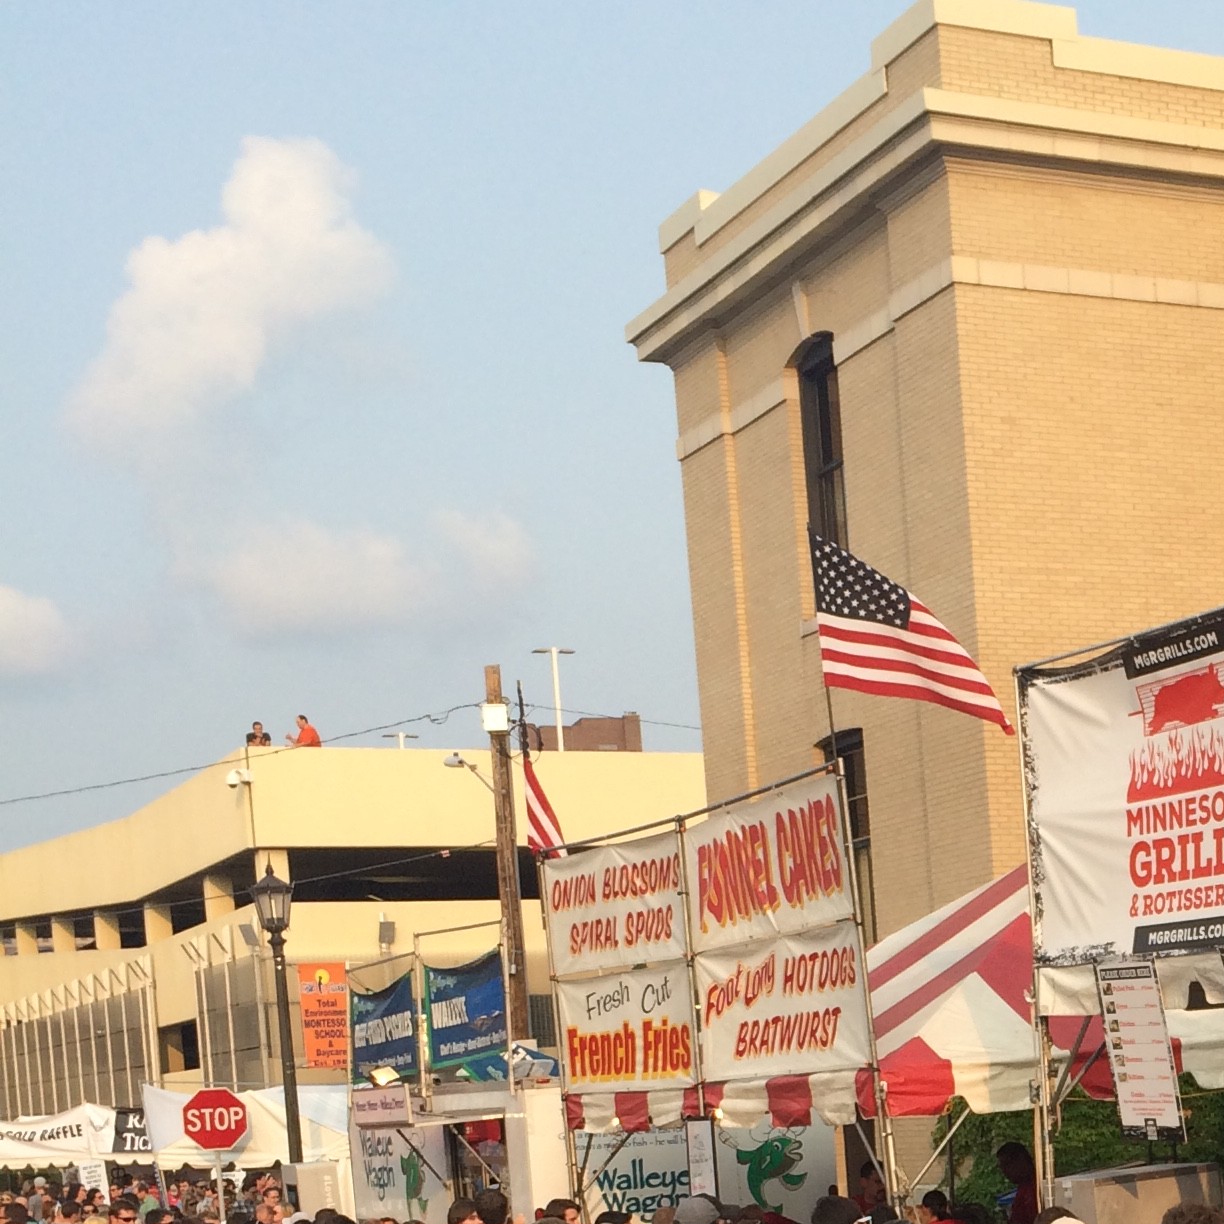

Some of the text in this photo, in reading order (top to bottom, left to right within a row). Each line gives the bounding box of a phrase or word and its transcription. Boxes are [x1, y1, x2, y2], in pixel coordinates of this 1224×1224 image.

[1133, 631, 1219, 669] MGRGRILLS.COM
[551, 852, 680, 912] ONION BLOSSOMS
[697, 793, 843, 933] FUNNEL CAKES
[1129, 894, 1139, 918] &
[570, 905, 673, 955] SPIRAL SPUDS
[586, 976, 672, 1020] Fresh Cut
[705, 945, 856, 1024] Foot Long HOTDOGS
[567, 1021, 636, 1081] French
[642, 1018, 691, 1079] Fries
[735, 1006, 841, 1059] BRATWURST
[40, 1124, 83, 1141] RAFFLE
[186, 1106, 244, 1133] STOP
[359, 1129, 393, 1158] Walleye
[364, 1159, 395, 1201] Wagon
[593, 1158, 690, 1198] Walleye
